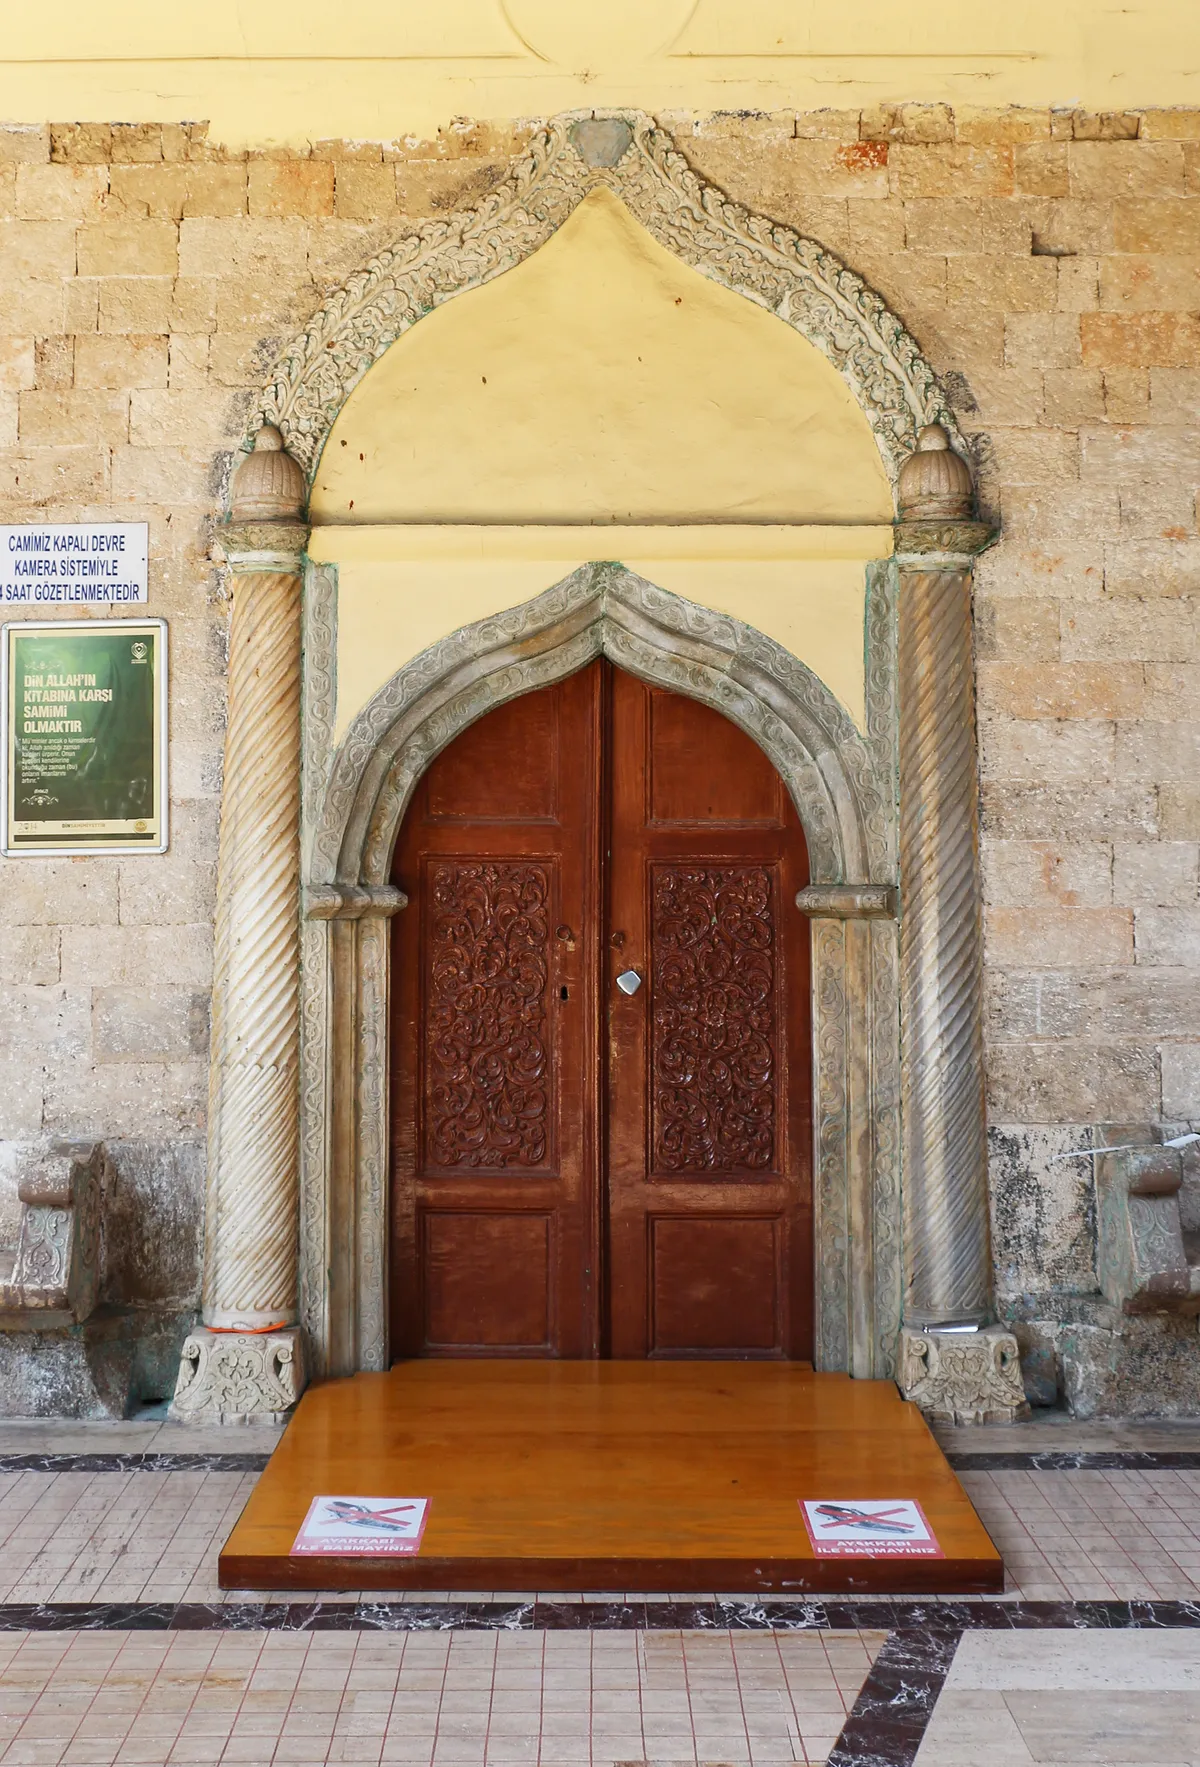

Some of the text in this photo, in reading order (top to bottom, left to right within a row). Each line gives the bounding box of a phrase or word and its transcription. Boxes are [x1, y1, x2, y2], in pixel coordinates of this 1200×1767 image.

[8, 532, 126, 552] CAMİMİZ KAPALI DEVRE
[14, 556, 119, 576] KAMERA SİSTEMİYLE
[5, 584, 32, 600] SAAT
[34, 580, 140, 600] GÖZETLENMEKTEDİR
[79, 689, 113, 702] KARŞI
[23, 720, 82, 733] OLMAKTIR
